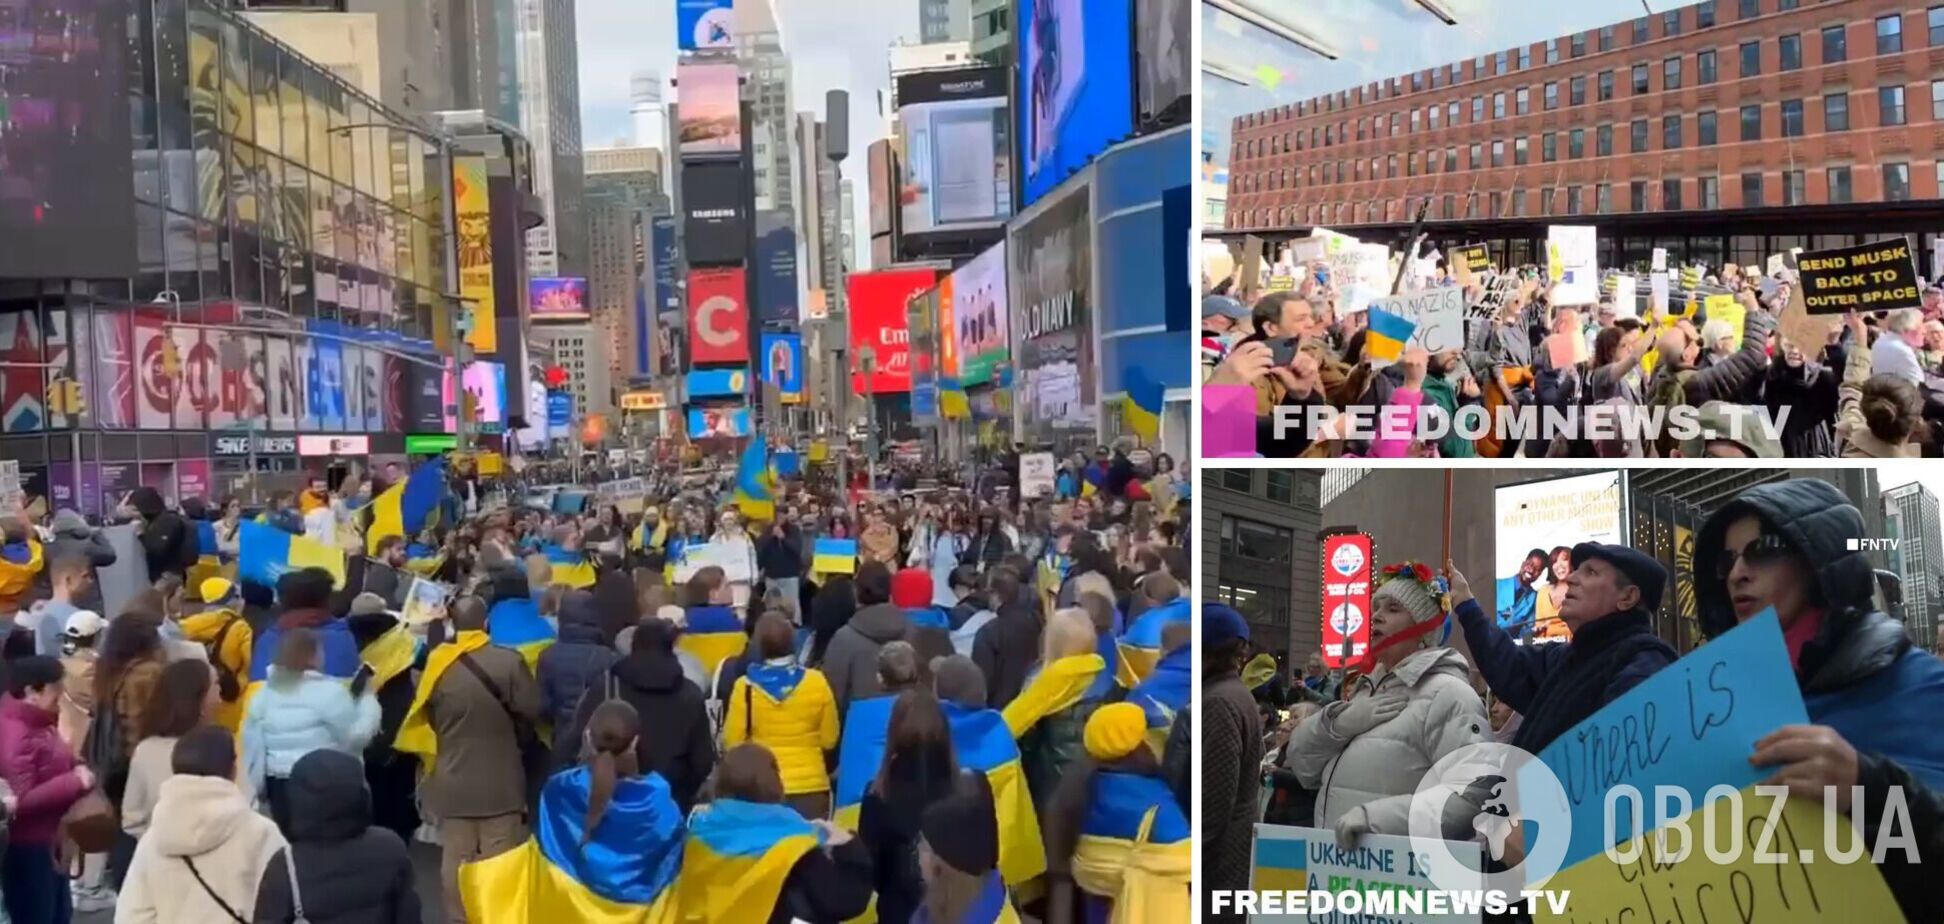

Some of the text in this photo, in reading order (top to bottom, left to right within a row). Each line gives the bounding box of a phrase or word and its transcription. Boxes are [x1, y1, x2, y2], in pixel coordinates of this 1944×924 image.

[1800, 246, 1908, 271] SEND MUSK
[1816, 269, 1897, 289] BACK TO
[1806, 287, 1917, 306] OUTER SPACE
[696, 295, 742, 347] C
[1020, 303, 1041, 340] OLD
[1310, 842, 1432, 878] UKRAINE IS
